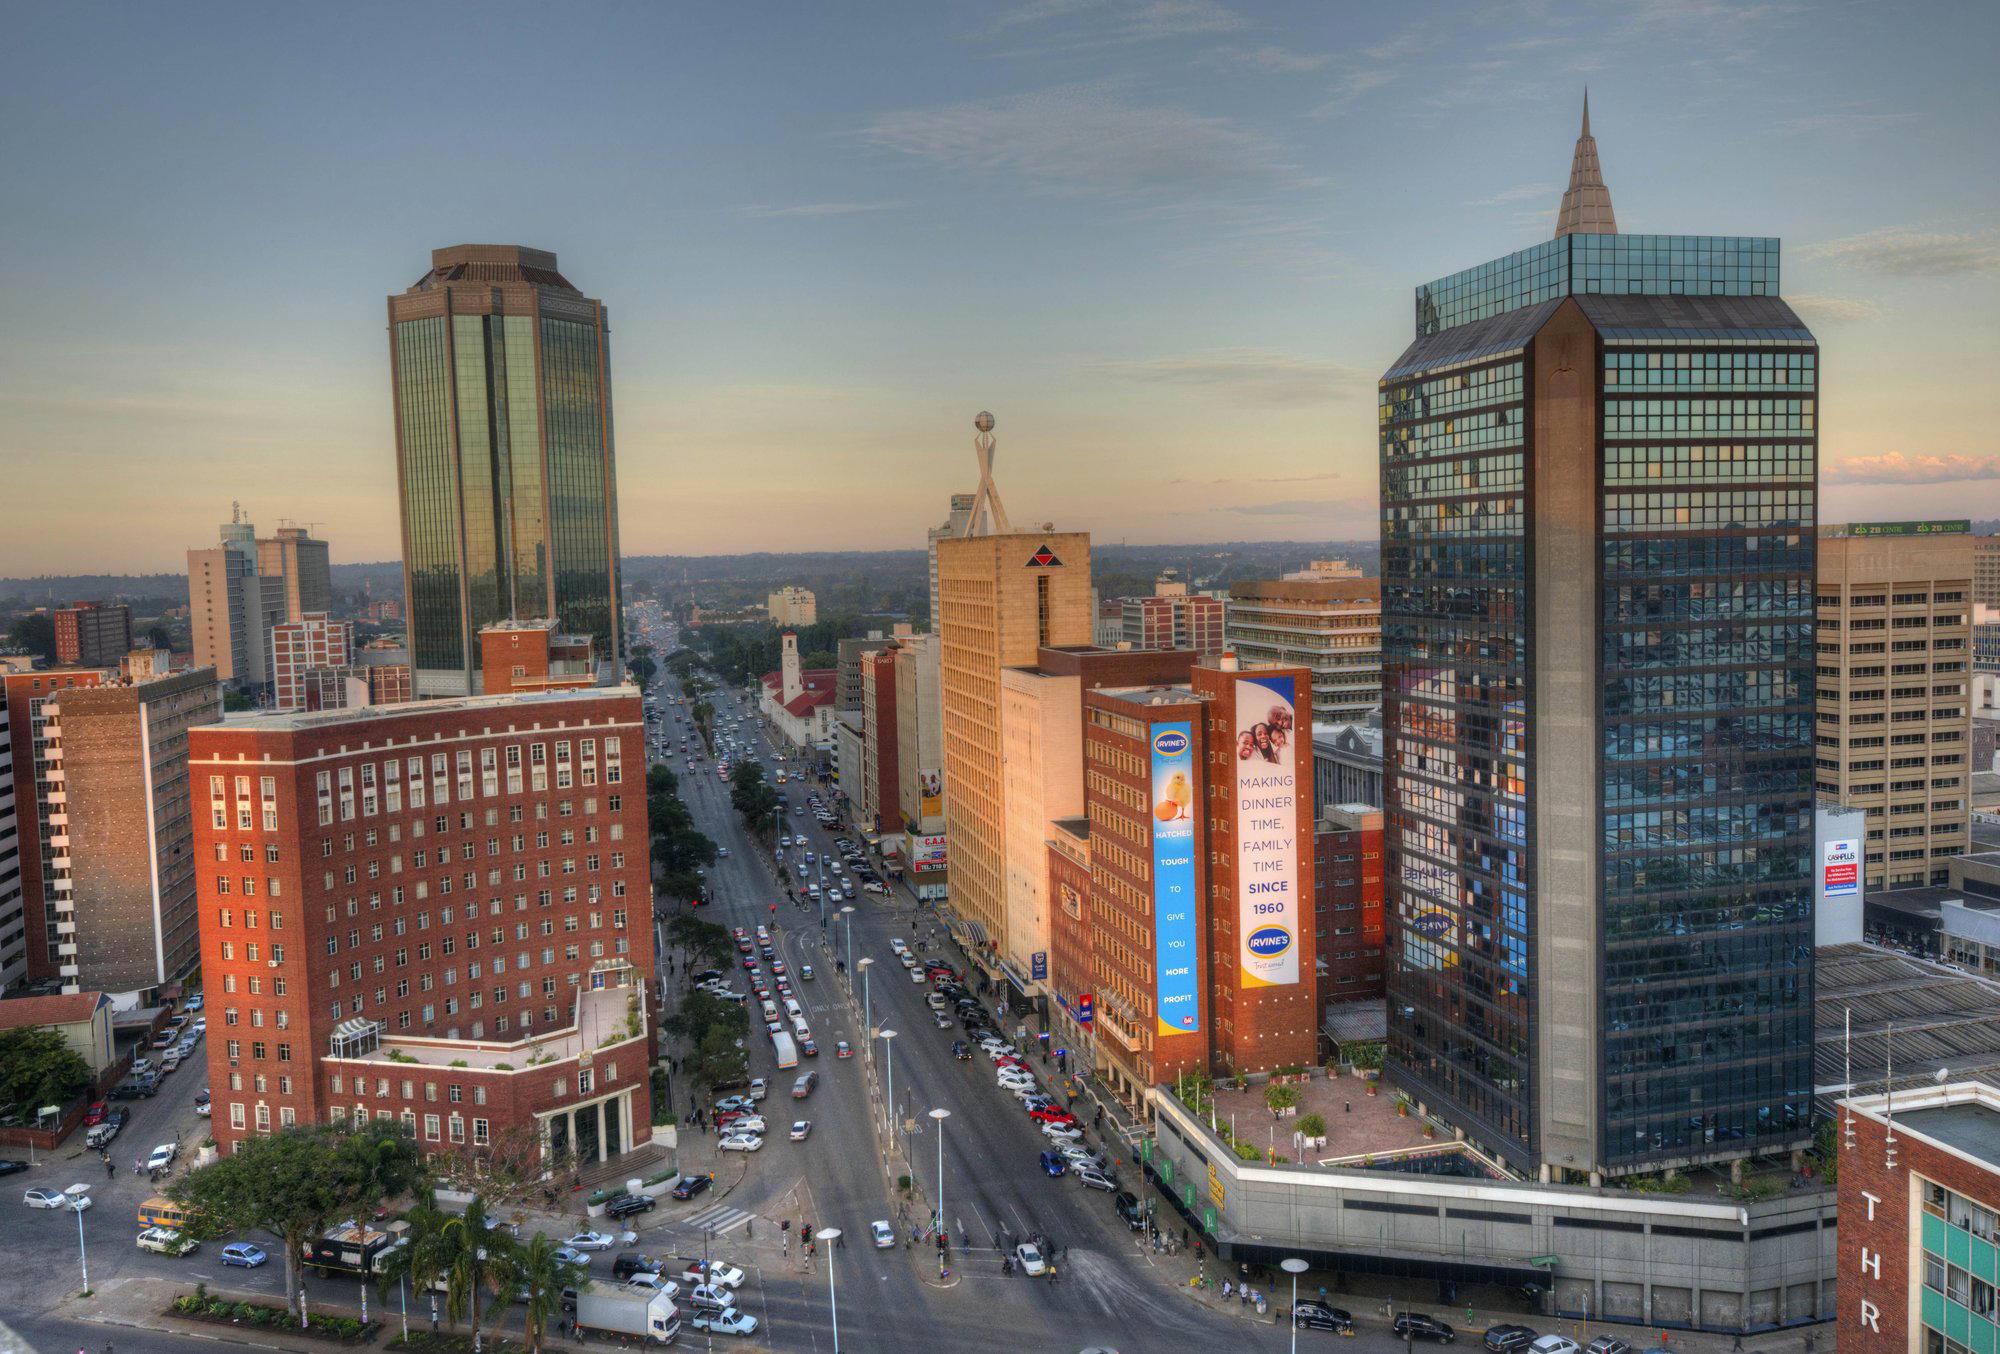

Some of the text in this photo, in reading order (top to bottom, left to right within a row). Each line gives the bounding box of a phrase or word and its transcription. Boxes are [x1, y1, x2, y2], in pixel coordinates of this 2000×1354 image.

[1157, 739, 1186, 748] IRVINE'S
[1240, 775, 1293, 789] MAKING
[1241, 796, 1292, 811] DINNER
[1155, 830, 1192, 839] HATCHED
[1243, 838, 1293, 853] FAMILY
[1161, 858, 1189, 866] TOUGH
[1253, 860, 1284, 872] TIME
[1248, 881, 1288, 894] SINCE
[1253, 902, 1285, 914] 1960
[1166, 913, 1185, 921] GIVE
[1168, 940, 1185, 948] YOU
[1250, 935, 1288, 948] IRVINE'S
[1165, 967, 1189, 976] MORE
[1163, 994, 1192, 1004] PROFIT
